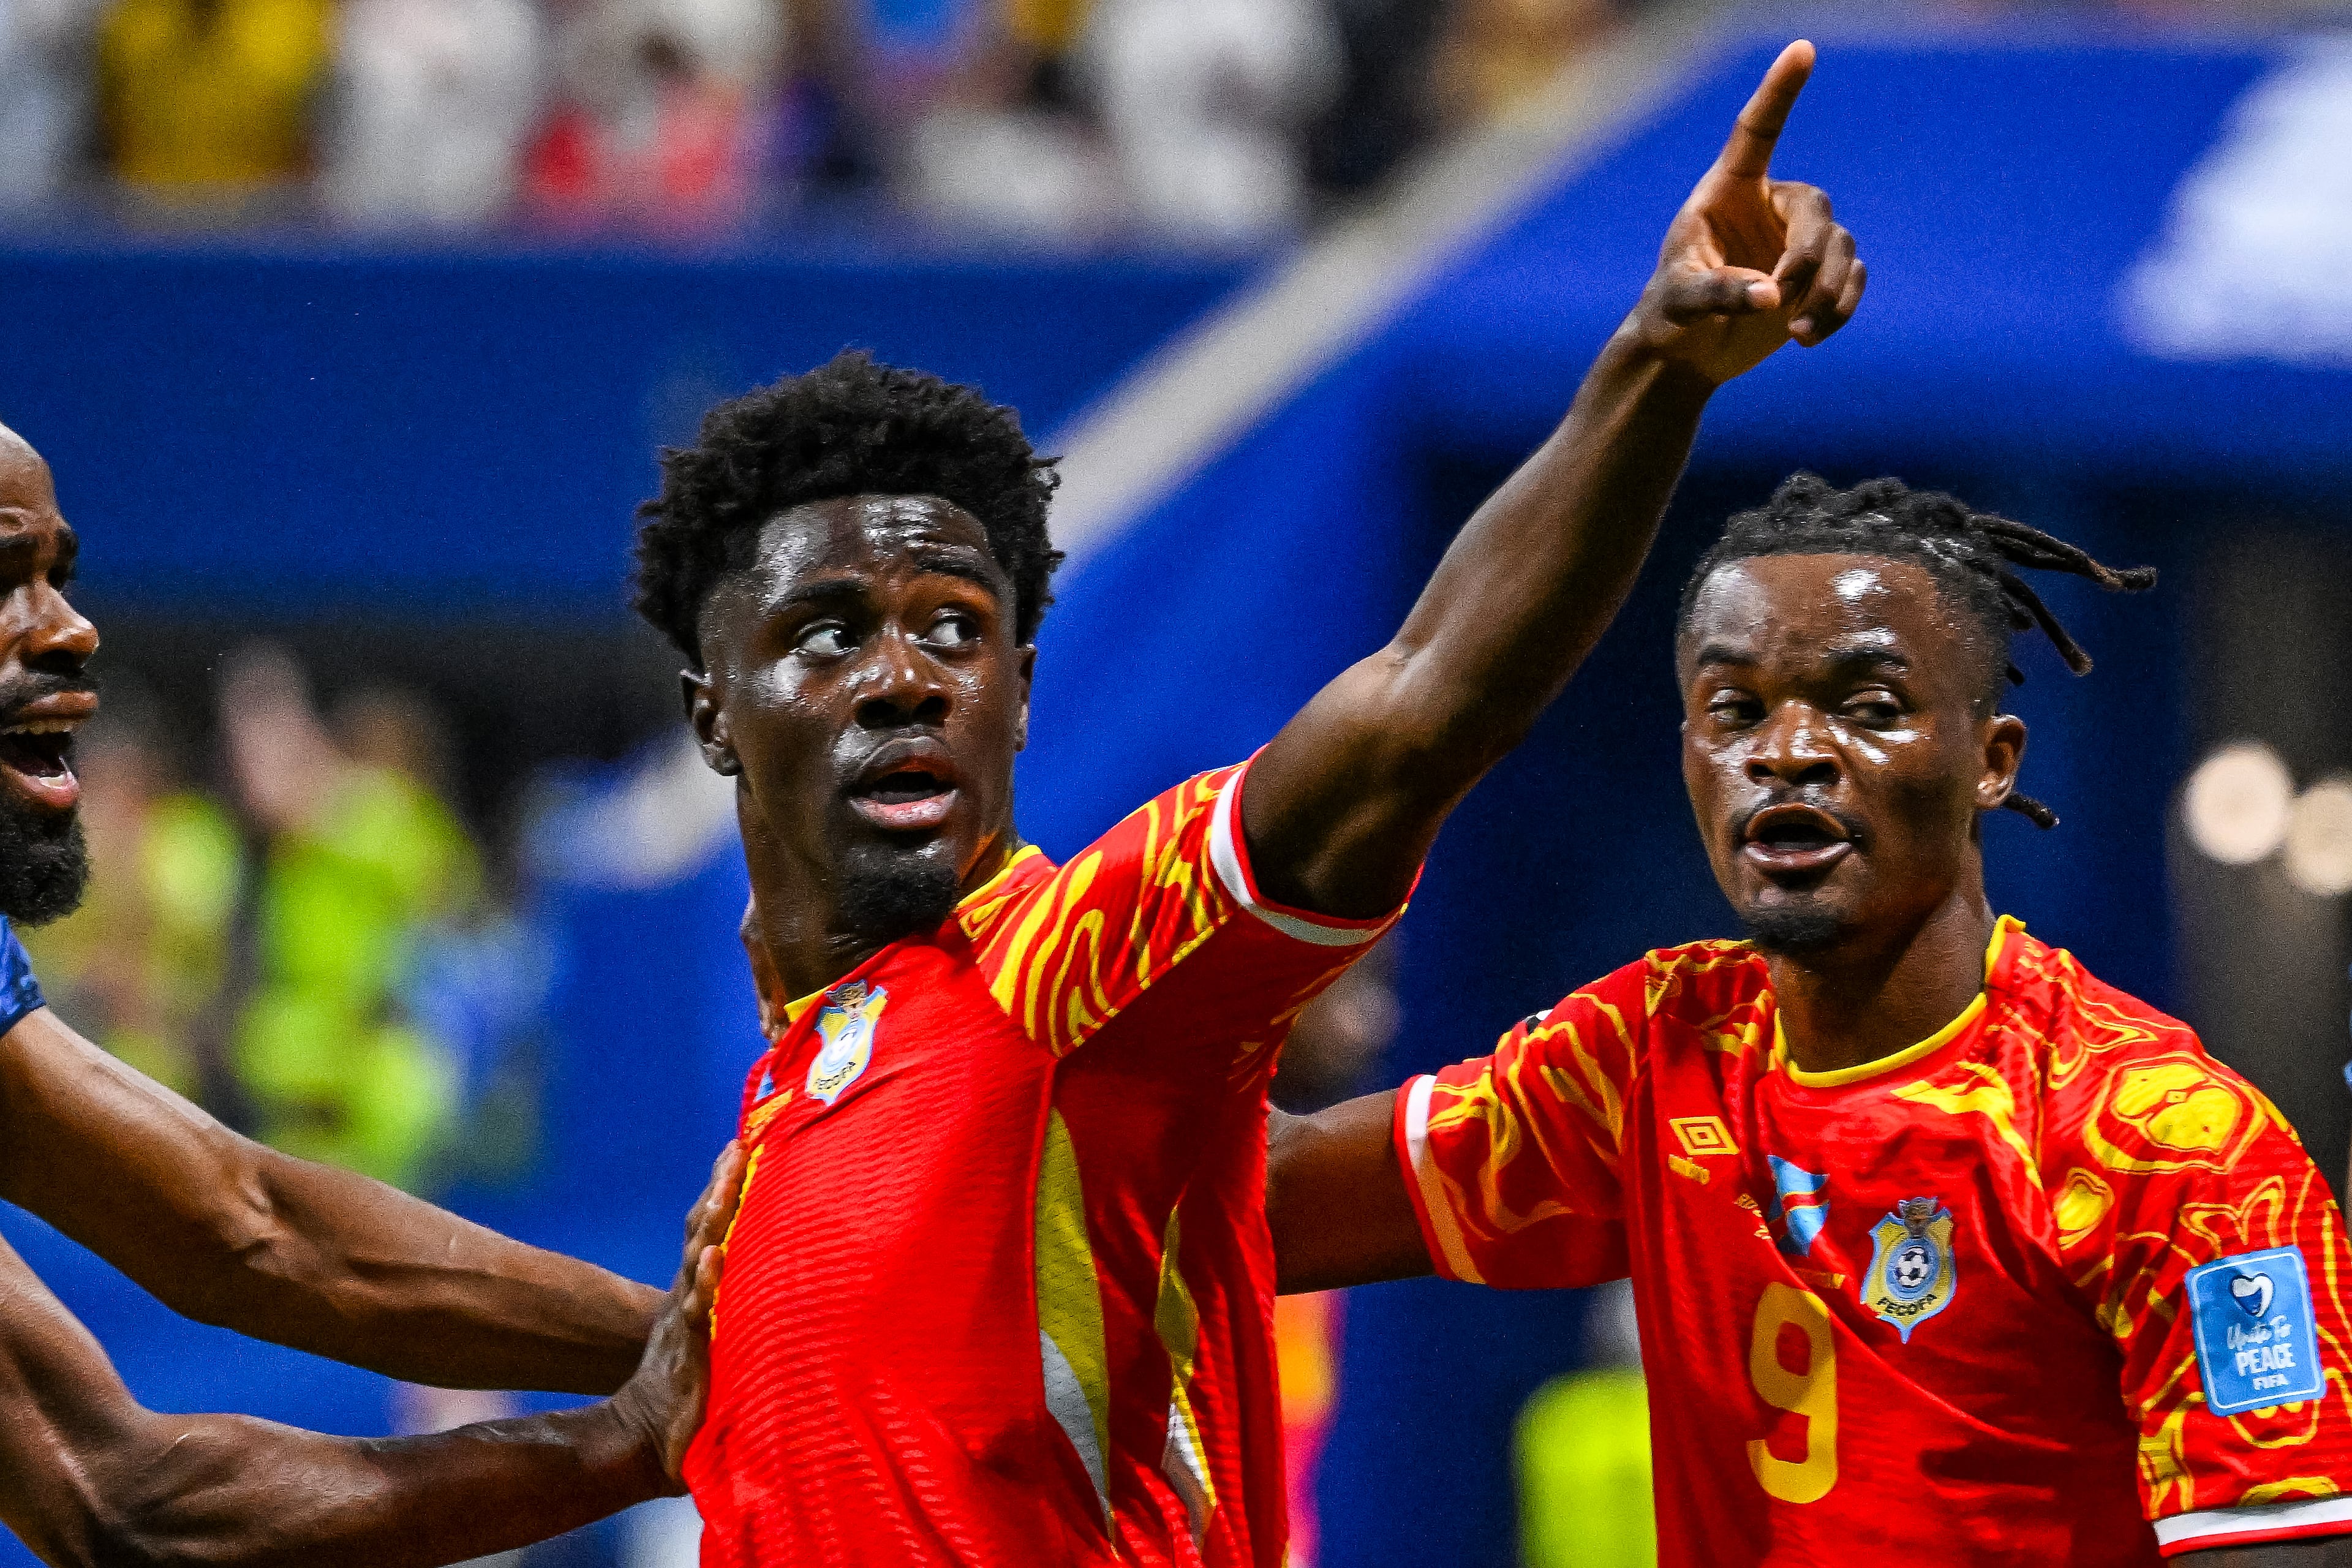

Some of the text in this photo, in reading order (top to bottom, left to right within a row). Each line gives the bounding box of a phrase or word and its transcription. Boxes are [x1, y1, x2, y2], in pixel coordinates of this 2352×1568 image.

[2236, 1343, 2296, 1376] PEACE
[1746, 1281, 1839, 1504] 9
[2253, 1374, 2290, 1390] FIFA
